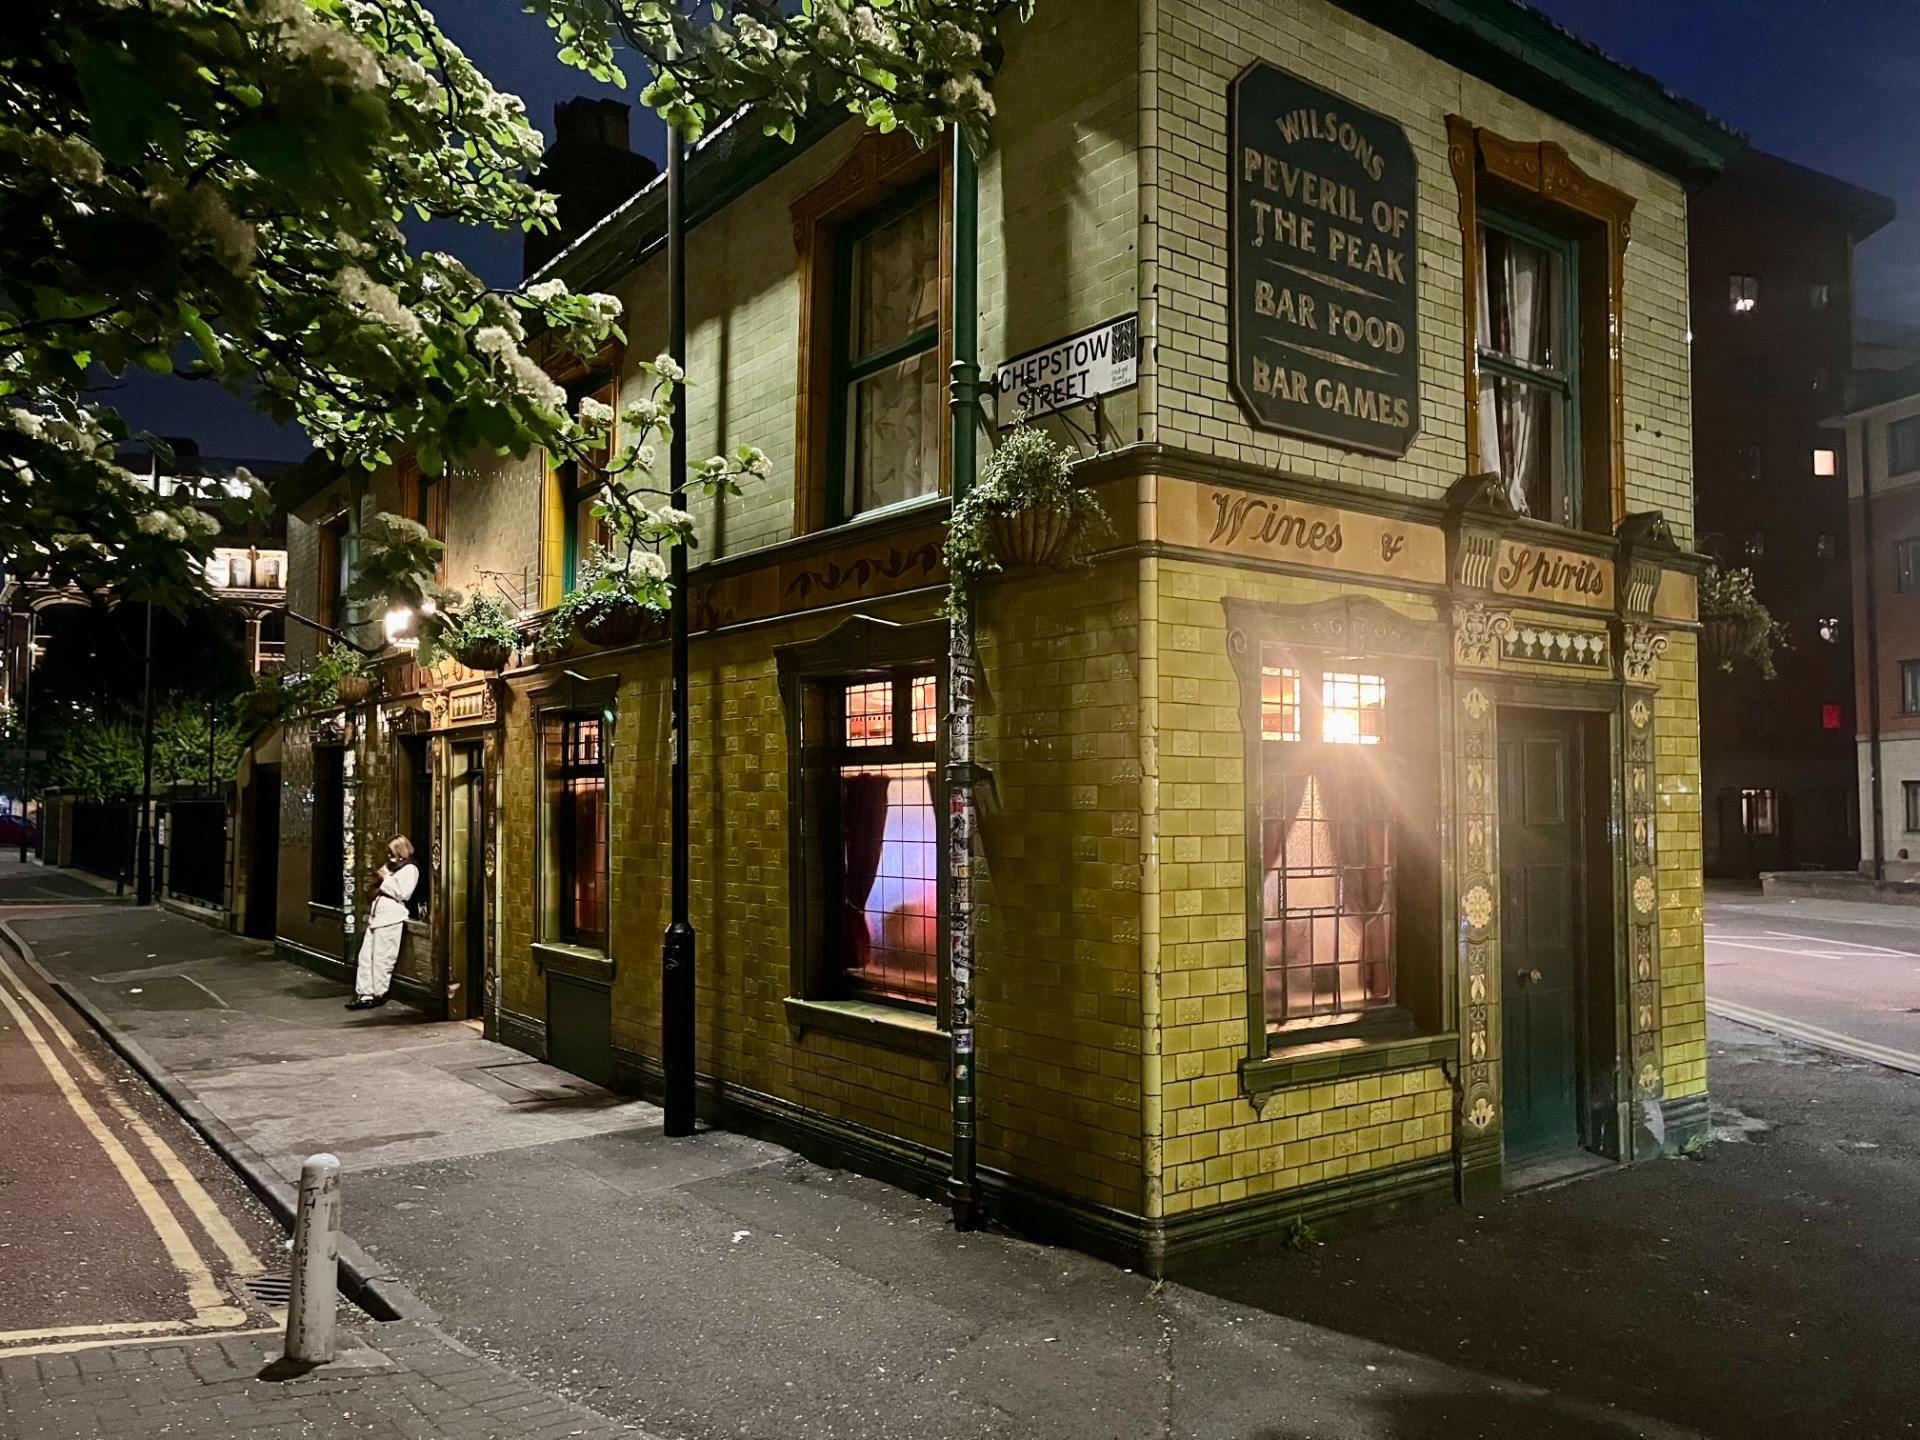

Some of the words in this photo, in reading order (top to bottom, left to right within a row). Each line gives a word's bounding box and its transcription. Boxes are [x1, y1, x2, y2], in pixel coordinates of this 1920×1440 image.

[1275, 109, 1385, 181] WILSONS
[1244, 147, 1364, 225] PEVERIL
[1371, 200, 1409, 238] OF
[1250, 199, 1316, 254] THE
[1328, 227, 1406, 285] PEAK
[1255, 279, 1318, 330] BAR
[1328, 302, 1405, 355] FOOD
[1000, 331, 1110, 393] CHEPSTOW
[1017, 368, 1090, 415] STREET
[1253, 355, 1309, 405] BAR
[1314, 378, 1410, 429] GAMES
[1209, 492, 1343, 553] Wines
[1381, 531, 1405, 562] &
[1498, 546, 1604, 596] Spirits
